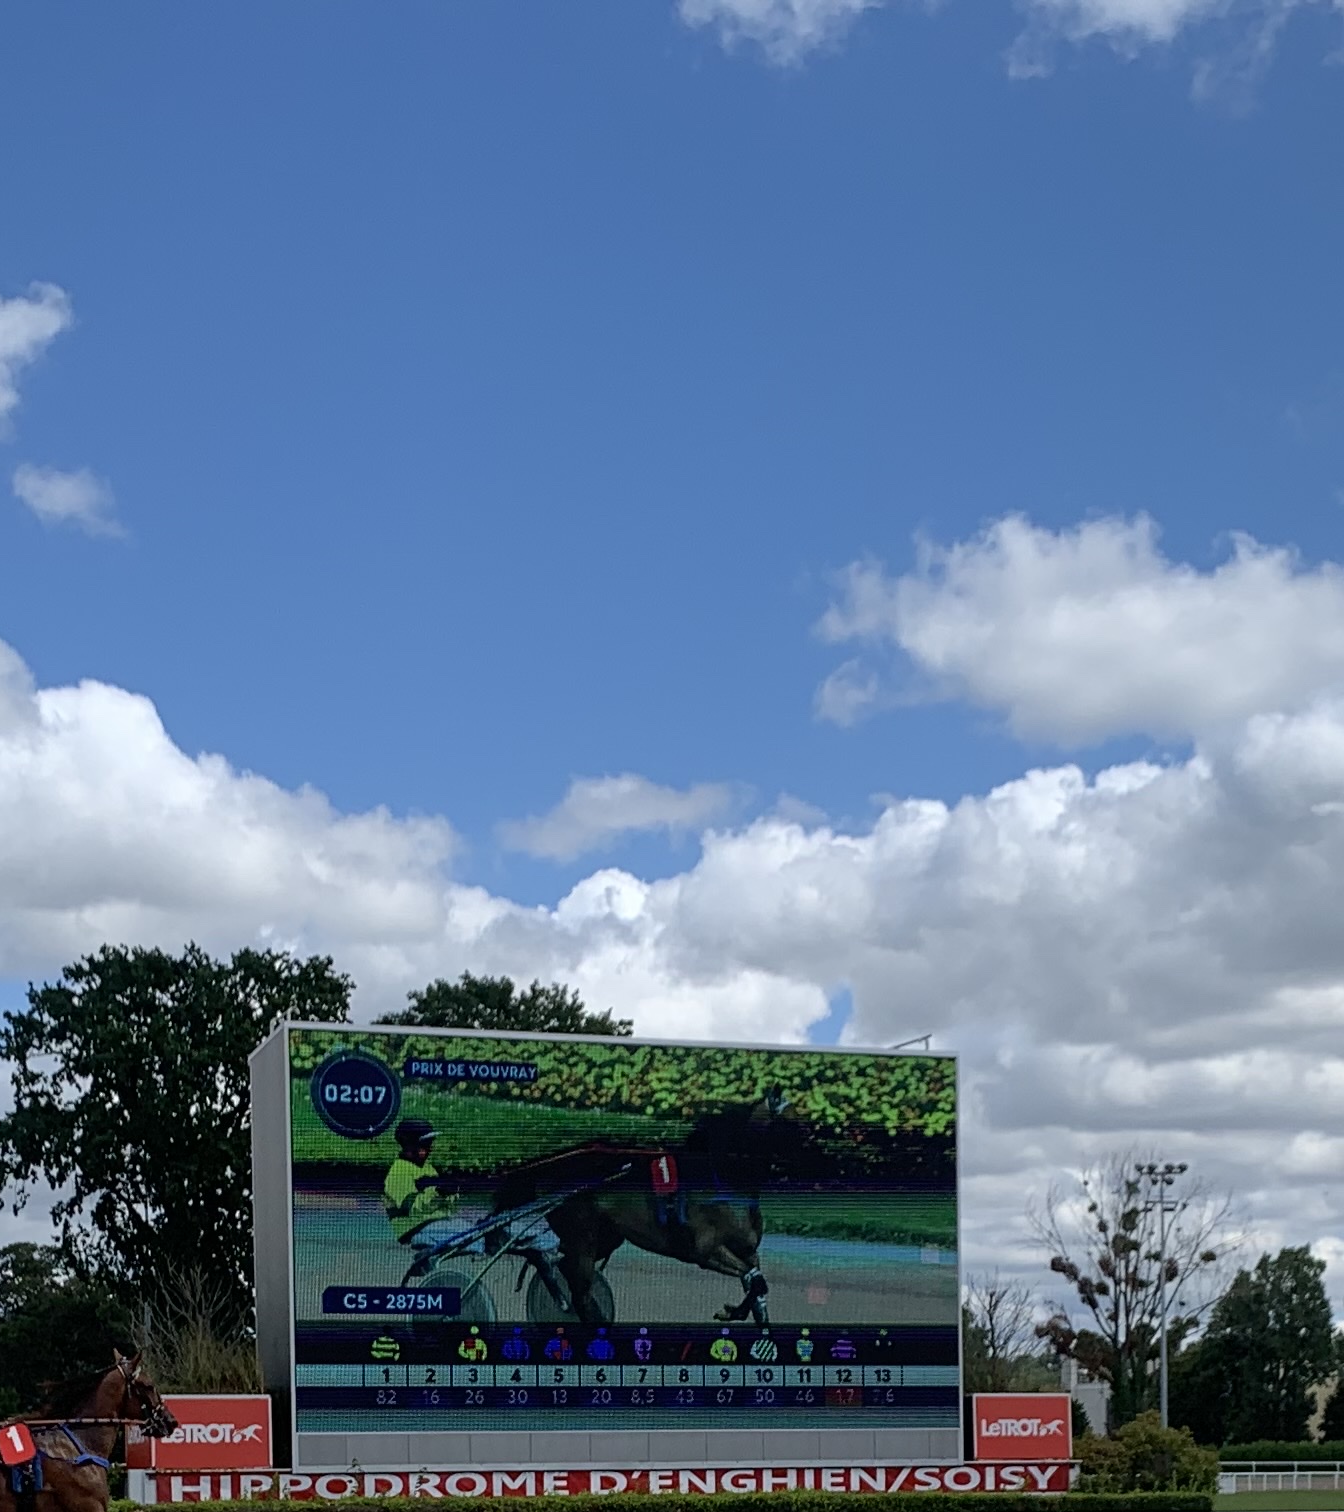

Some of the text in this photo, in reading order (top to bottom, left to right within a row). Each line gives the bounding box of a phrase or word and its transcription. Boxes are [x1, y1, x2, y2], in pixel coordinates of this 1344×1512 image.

[411, 1061, 537, 1079] PRIX DE VOUVRAY
[324, 1083, 387, 1104] 02:07
[658, 1155, 670, 1184] 1
[343, 1293, 367, 1309] C5
[386, 1293, 443, 1310] 2875M
[381, 1368, 892, 1384] 1 2 3 4 5 6 7 8 9 10 11 12 13
[376, 1389, 397, 1405] 82
[465, 1389, 485, 1405] 26
[507, 1389, 528, 1405] 30
[552, 1389, 567, 1405] 13
[591, 1389, 612, 1405] 20
[716, 1389, 734, 1405] 67
[6, 1425, 24, 1453] 1
[170, 1471, 570, 1502] HIPPODROME
